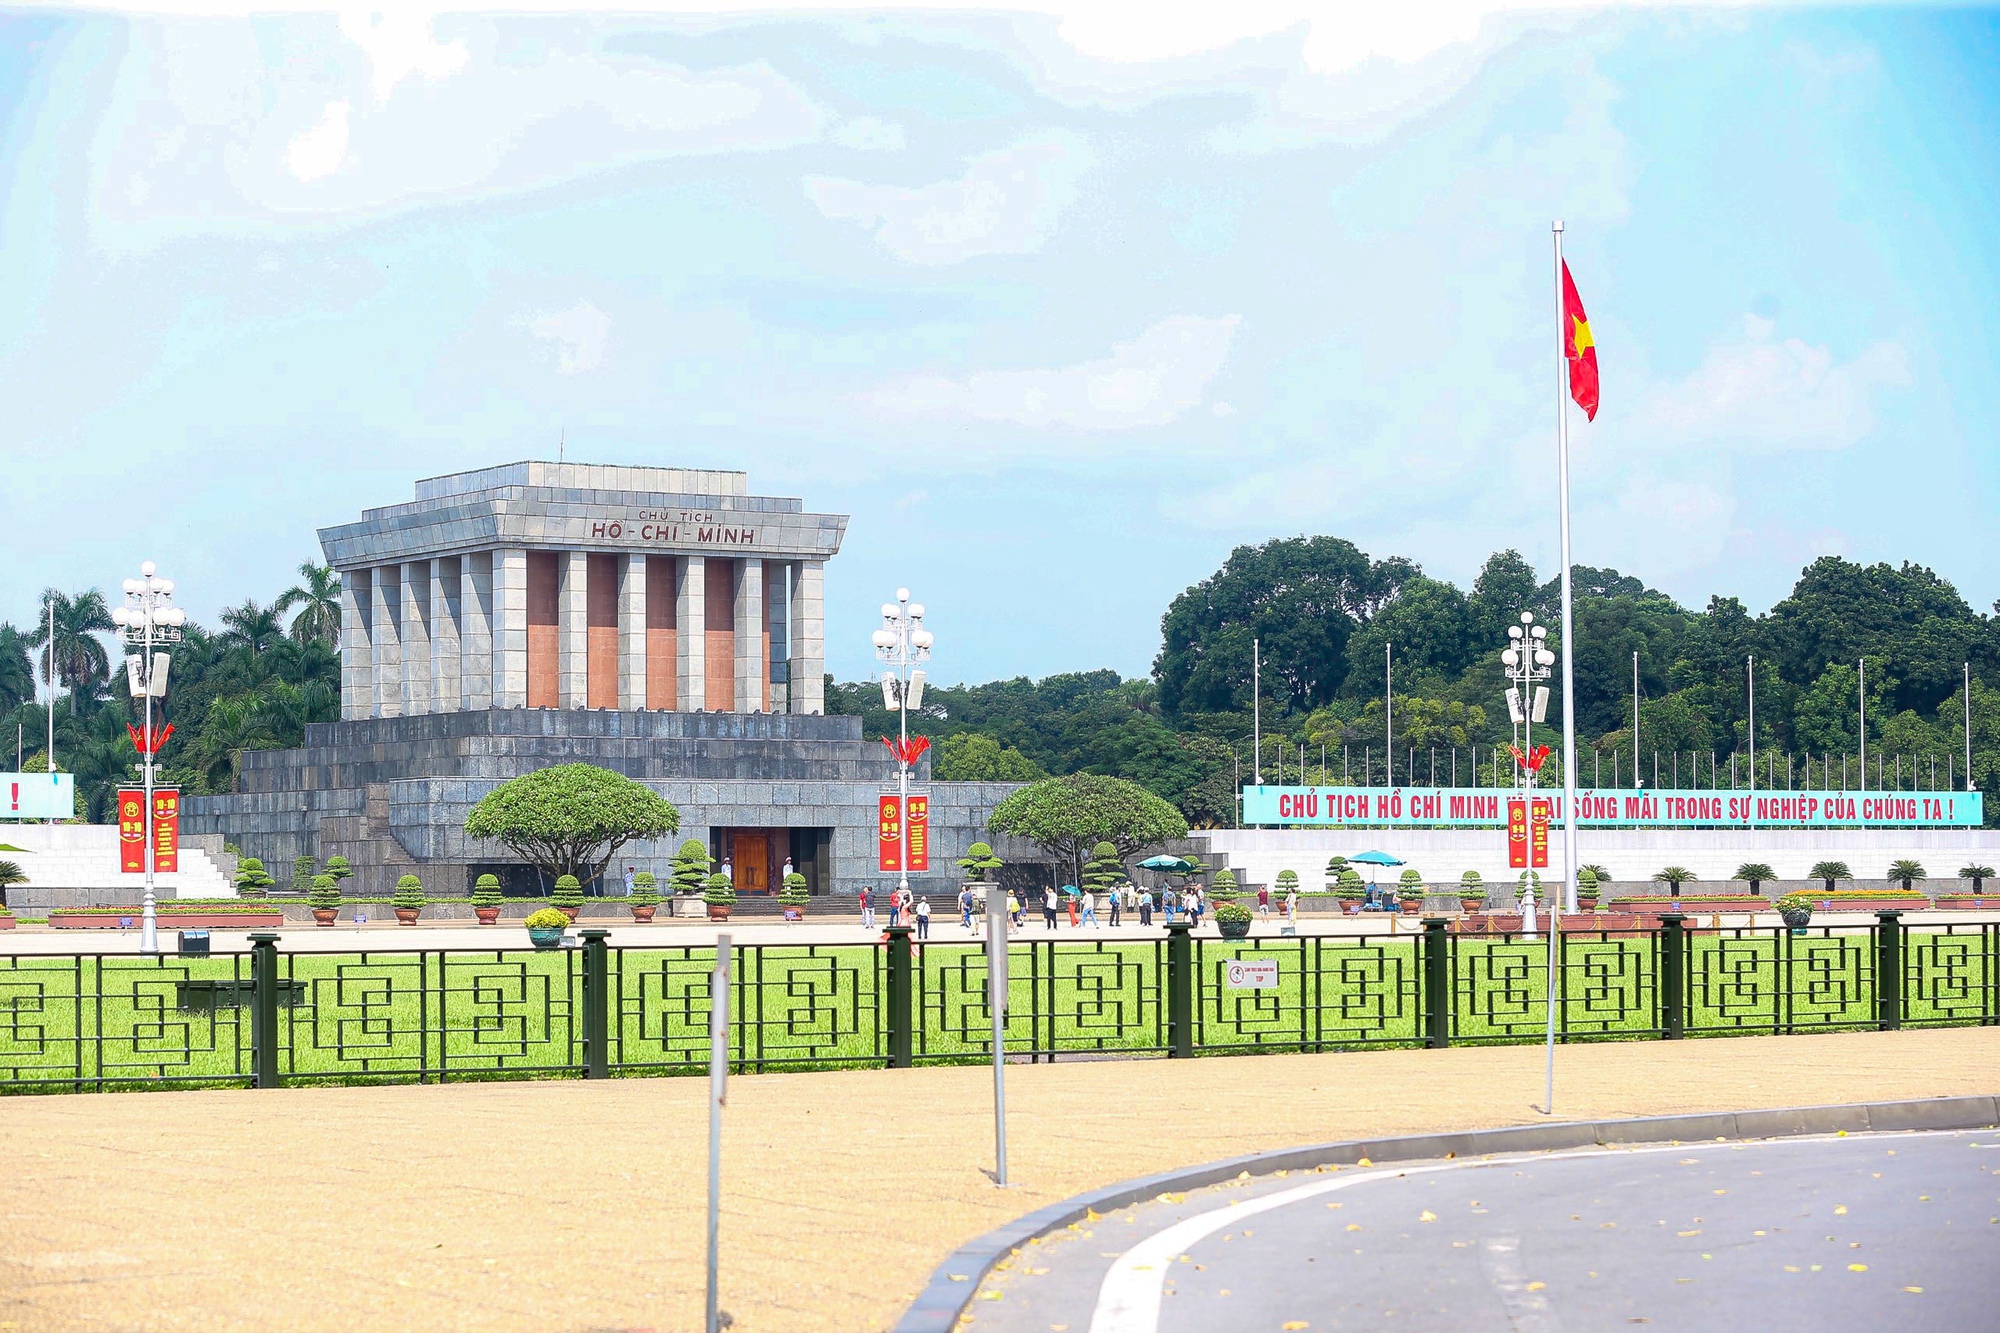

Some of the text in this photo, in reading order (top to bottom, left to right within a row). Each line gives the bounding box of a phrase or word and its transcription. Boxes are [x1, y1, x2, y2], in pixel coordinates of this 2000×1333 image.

[639, 508, 713, 525] CHỦ TỊCH
[592, 520, 623, 538] HỒ
[641, 522, 679, 541] CHÍ
[12, 783, 18, 810] !
[1279, 788, 1318, 818] CHỦ
[1326, 794, 1369, 822] TỊCH
[1377, 788, 1402, 818] HỒ
[1410, 791, 1441, 818] CHÍ
[1450, 796, 1498, 818] MINH
[1625, 793, 1657, 819] MÃI
[1666, 797, 1721, 819] TRONG
[1729, 795, 1752, 823] SỰ
[1757, 794, 1818, 823] NGHIỆP
[1824, 792, 1856, 819] CỦA
[1862, 794, 1917, 819] CHÚNG
[1923, 799, 1942, 819] TA
[1948, 799, 1953, 819] !
